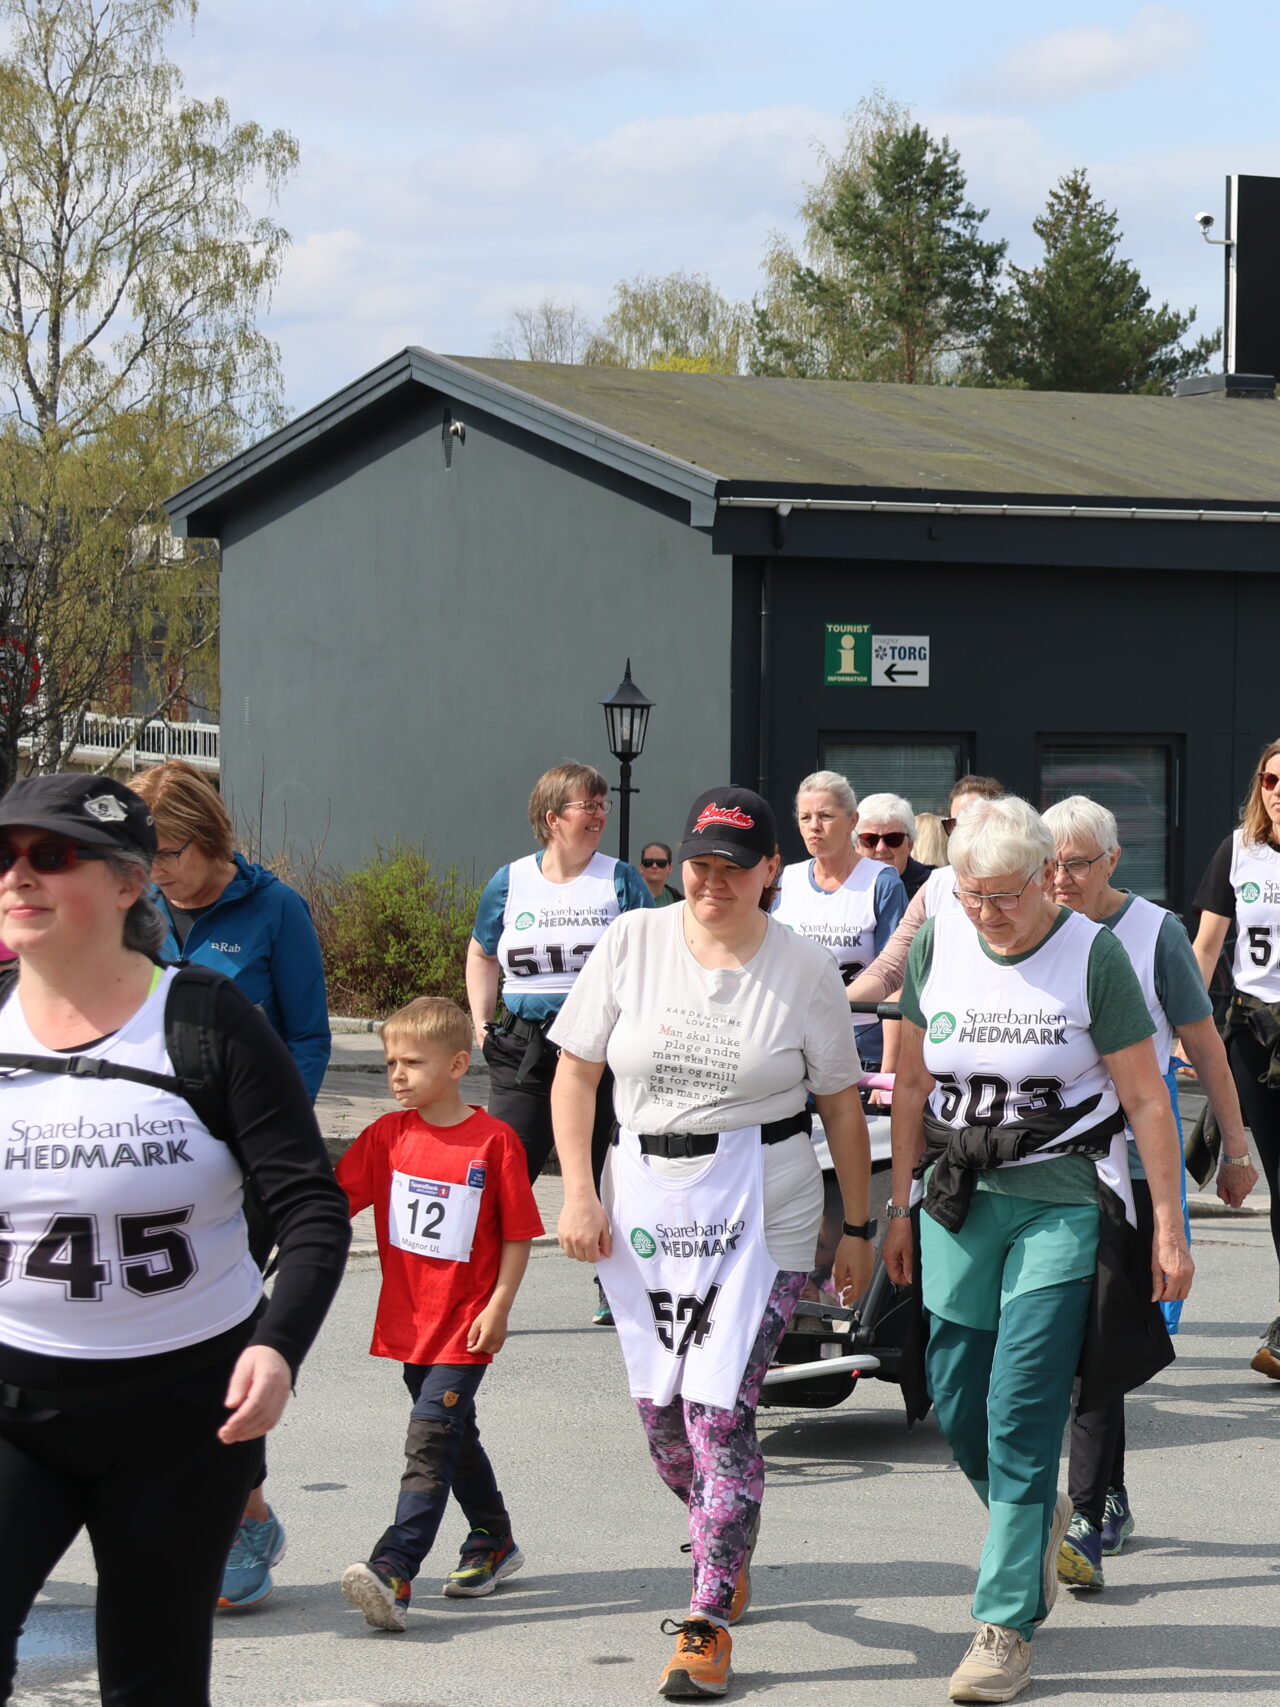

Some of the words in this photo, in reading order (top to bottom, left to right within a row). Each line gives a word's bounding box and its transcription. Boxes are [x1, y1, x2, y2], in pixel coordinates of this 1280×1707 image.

[826, 624, 869, 633] TOURIST
[889, 646, 927, 661] TORG
[539, 906, 608, 919] Sparebanken
[538, 916, 610, 928] HEDMARK
[799, 922, 863, 936] Sparebanken
[220, 942, 241, 953] Rab
[803, 934, 863, 947] DMARK
[686, 1018, 719, 1030] LOVEN
[963, 1008, 1067, 1026] Sparebanken
[659, 1023, 683, 1038] Man
[686, 1031, 711, 1042] skal
[714, 1036, 740, 1047] ikke
[958, 1026, 1069, 1045] HEDMARK
[663, 1040, 702, 1053] plage
[704, 1046, 741, 1059] andre
[652, 1050, 681, 1062] man
[683, 1053, 709, 1066] skal
[710, 1059, 739, 1071] være
[655, 1063, 684, 1074] grei
[687, 1067, 703, 1079] og
[650, 1075, 665, 1085] og
[669, 1075, 690, 1086] for
[648, 1082, 674, 1095] kan
[676, 1088, 701, 1100] man
[652, 1094, 674, 1108] hva
[7, 1113, 187, 1147] Sparebanken
[4, 1138, 195, 1171] HEDMARK
[407, 1198, 446, 1240] 12
[655, 1218, 745, 1241] Sparebanken
[0, 1204, 199, 1302] 45
[402, 1237, 428, 1250] Magnor
[429, 1244, 441, 1253] UL
